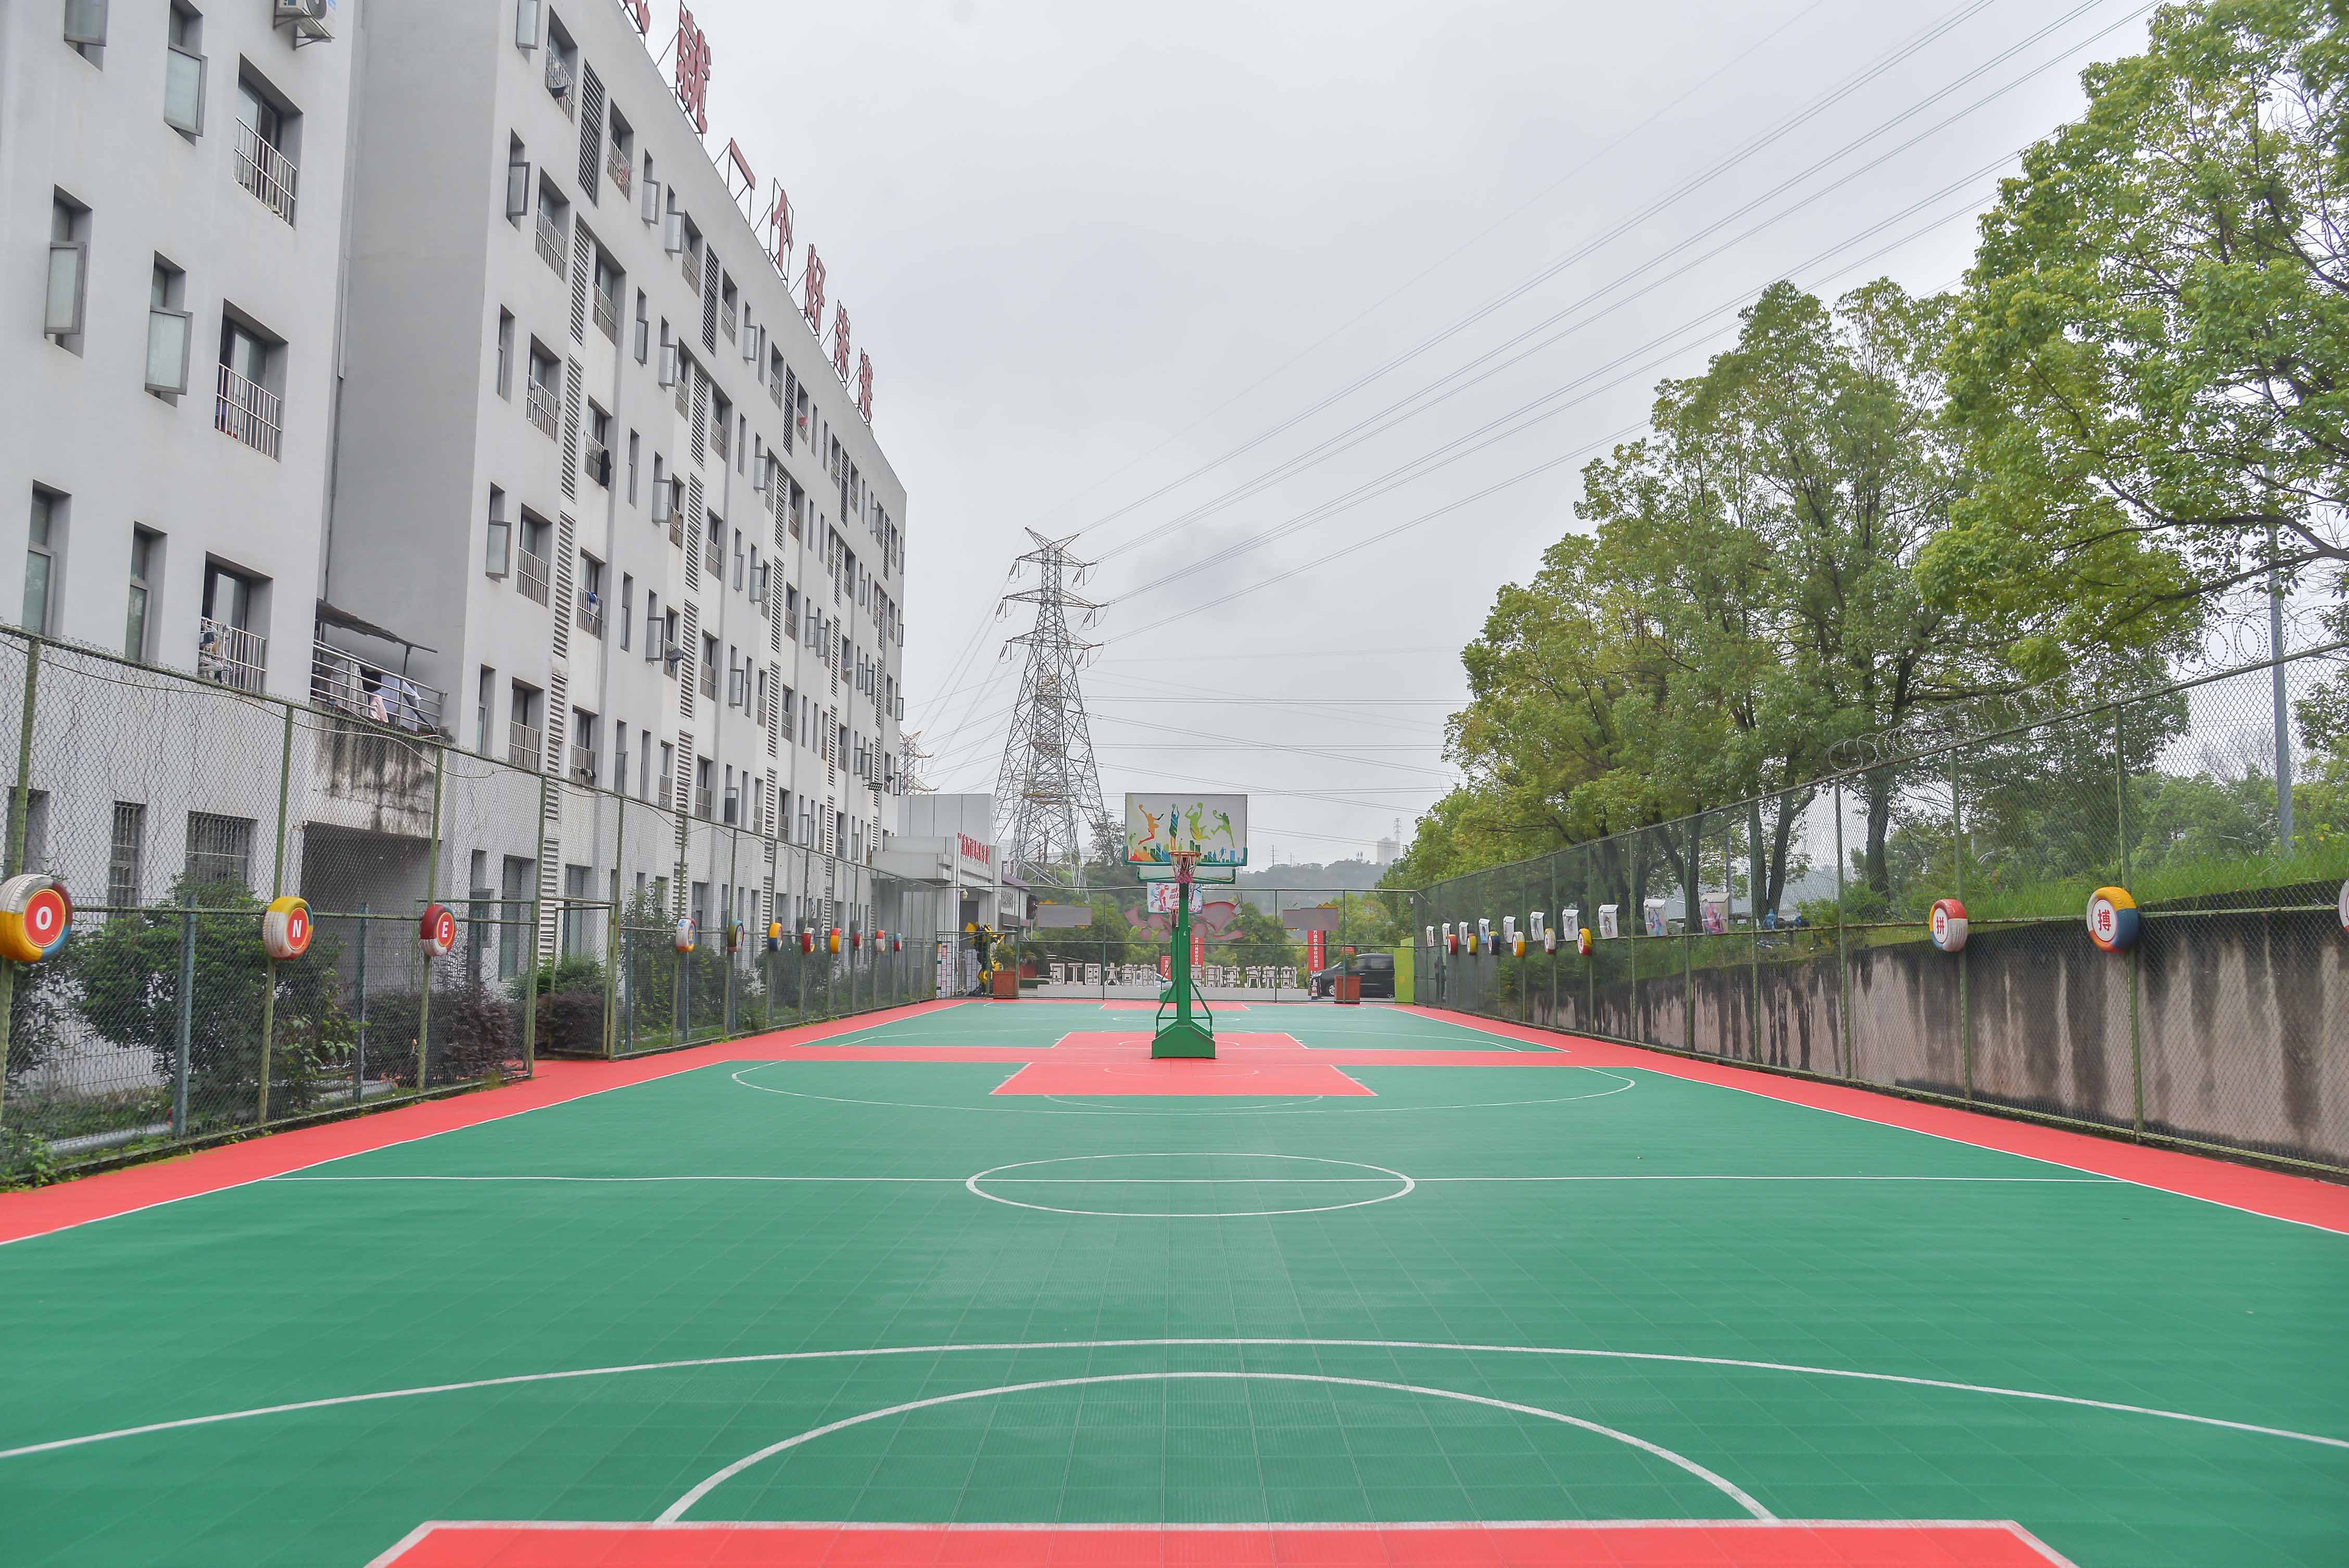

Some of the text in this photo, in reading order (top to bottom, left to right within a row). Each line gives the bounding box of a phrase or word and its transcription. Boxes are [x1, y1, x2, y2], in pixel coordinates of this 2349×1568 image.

[625, 0, 874, 422] 就一个好未来
[36, 906, 52, 930] O
[1937, 916, 1944, 934] 拼
[292, 919, 302, 938] N
[441, 921, 449, 938] E
